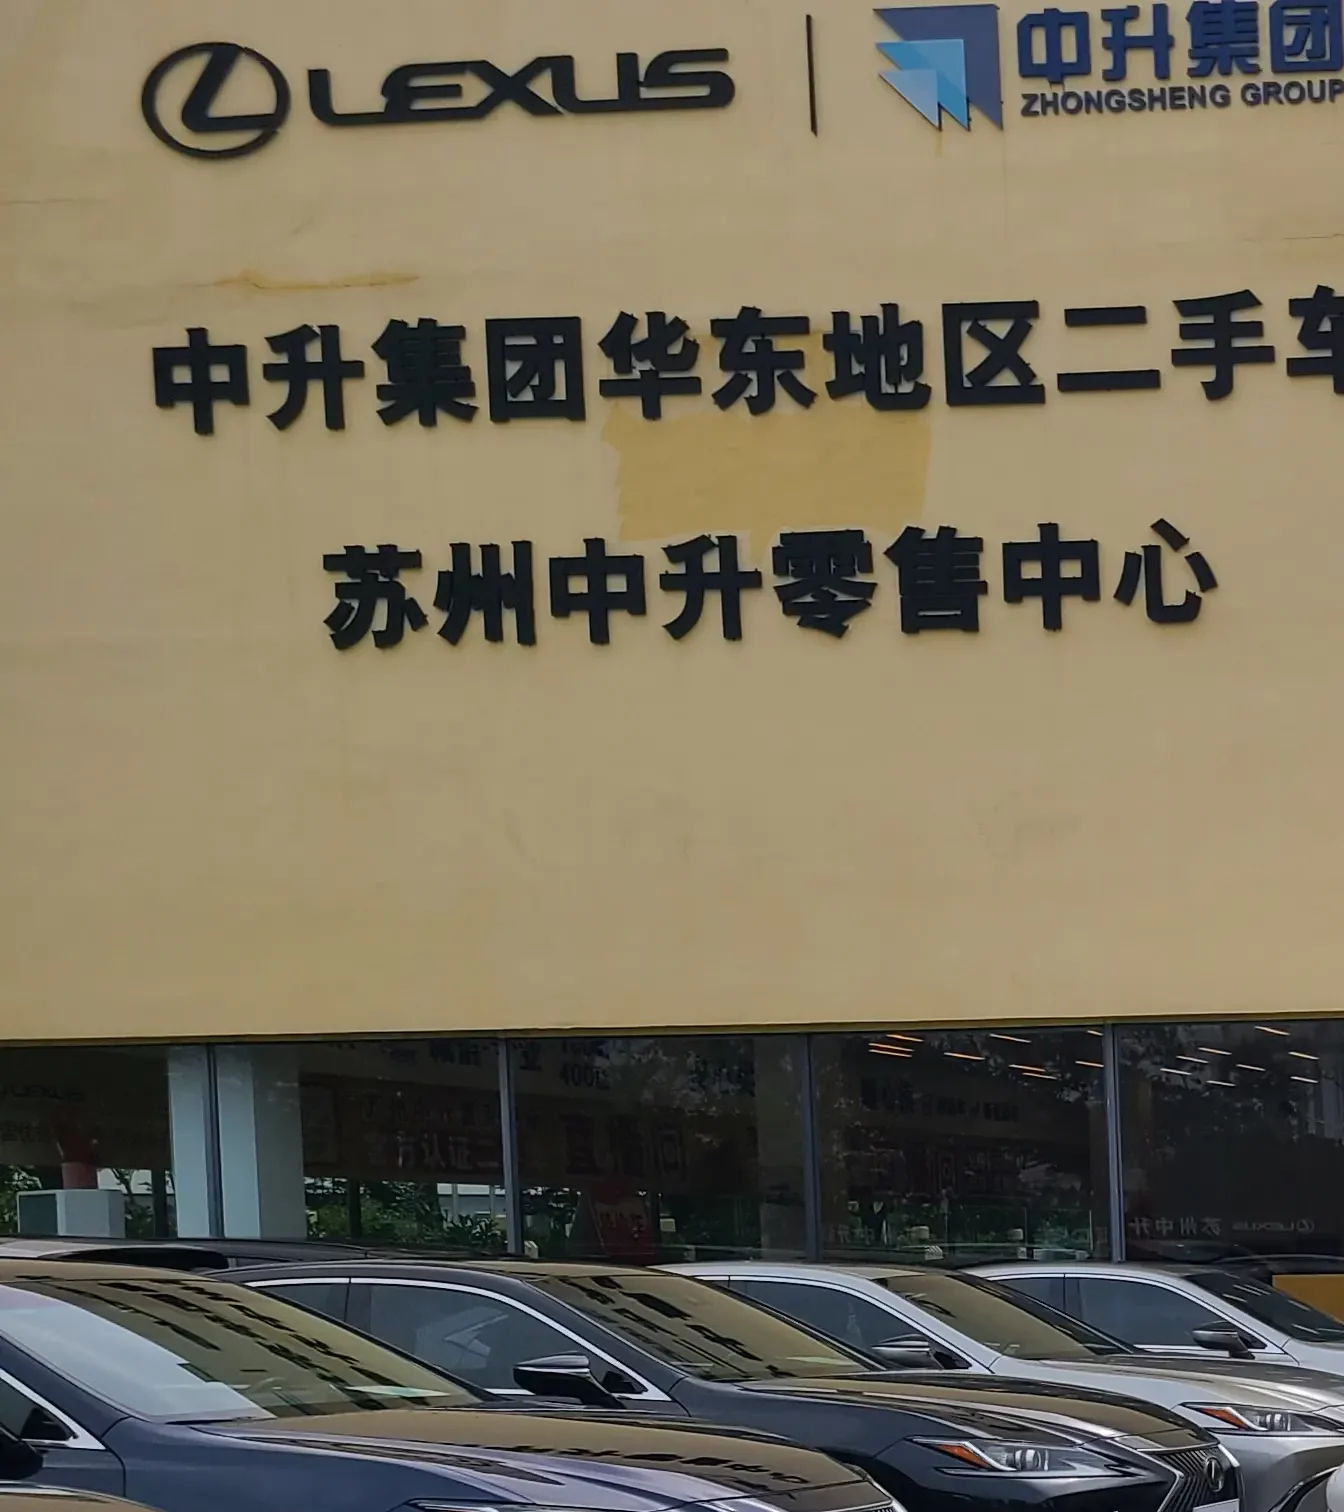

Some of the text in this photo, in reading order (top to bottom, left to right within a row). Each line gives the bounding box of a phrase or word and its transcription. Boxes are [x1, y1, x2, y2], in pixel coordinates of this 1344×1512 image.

[1017, 0, 1344, 84] 中升集团
[308, 48, 736, 127] LEXUS
[1021, 84, 1232, 117] ZHONGSHENG
[323, 518, 1218, 650] 苏州中升零售中心
